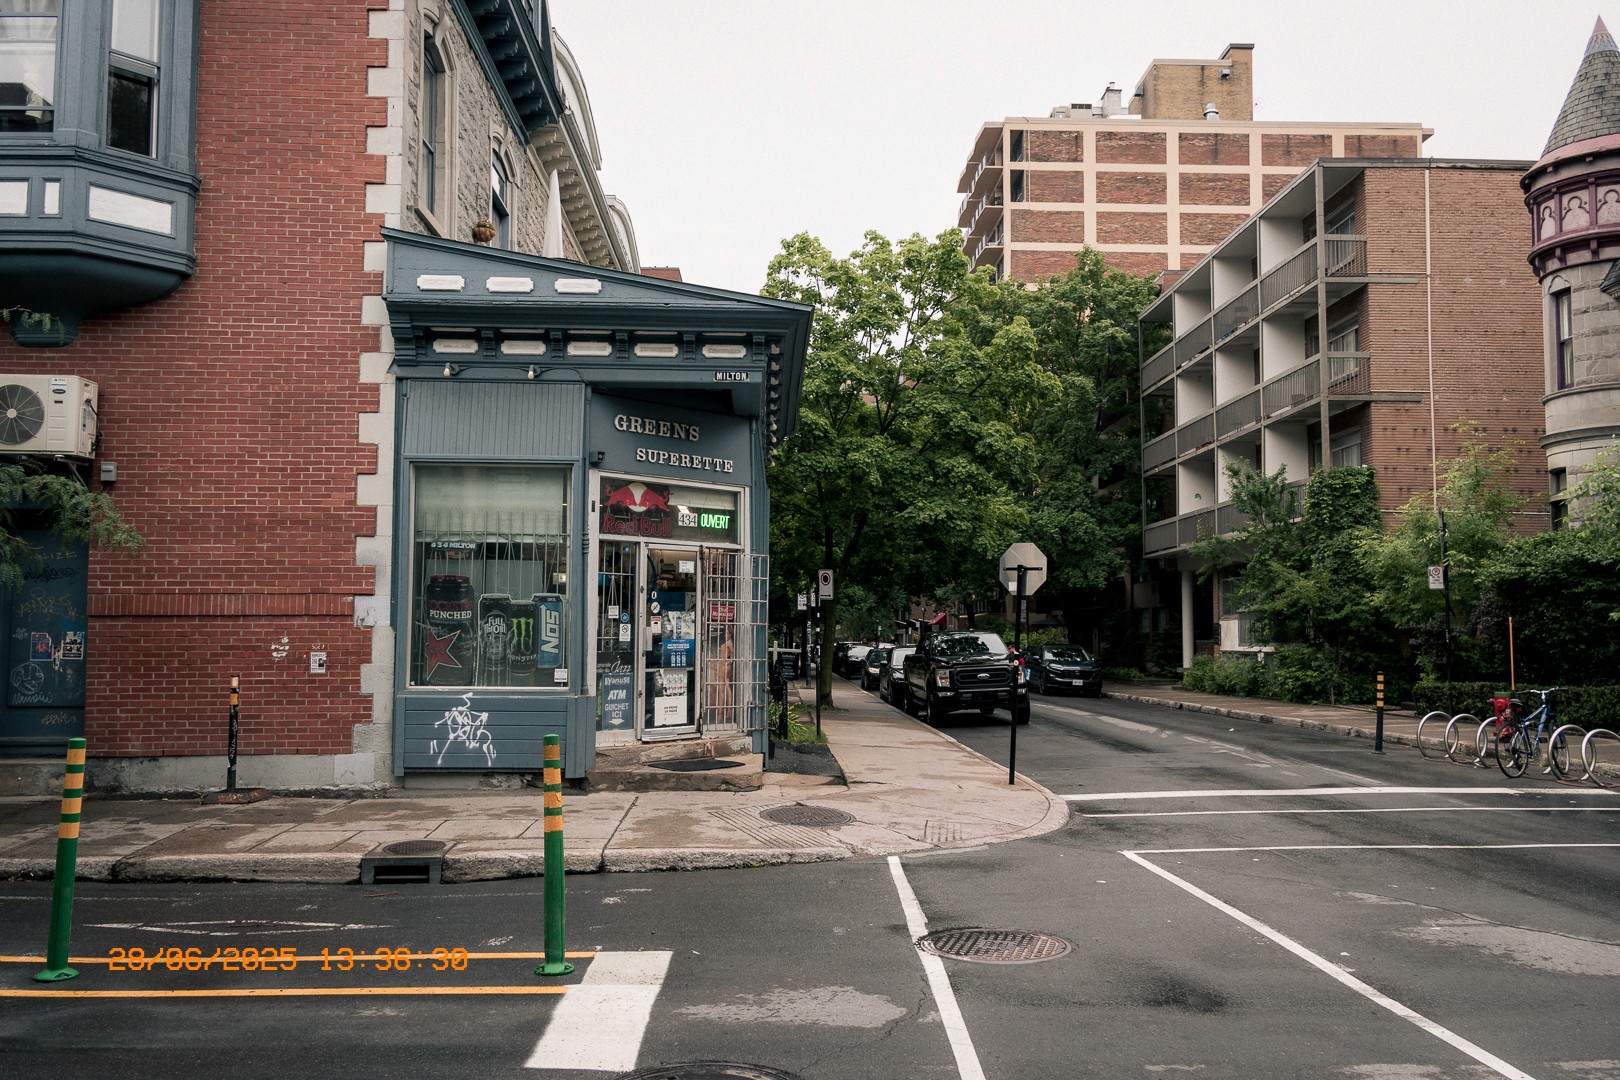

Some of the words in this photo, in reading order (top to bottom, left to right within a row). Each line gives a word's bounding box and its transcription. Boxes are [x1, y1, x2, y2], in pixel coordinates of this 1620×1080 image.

[716, 372, 747, 381] MILTON
[614, 414, 700, 441] GREEN'S
[636, 448, 733, 473] SUPERETTE
[603, 514, 638, 535] Red
[640, 516, 672, 537] Bull
[679, 513, 697, 526] 434
[700, 513, 730, 529] OUVERT
[429, 609, 472, 619] PUNCHED
[540, 604, 559, 654] NOS
[608, 690, 626, 700] ATM
[604, 702, 629, 711] GUICHET
